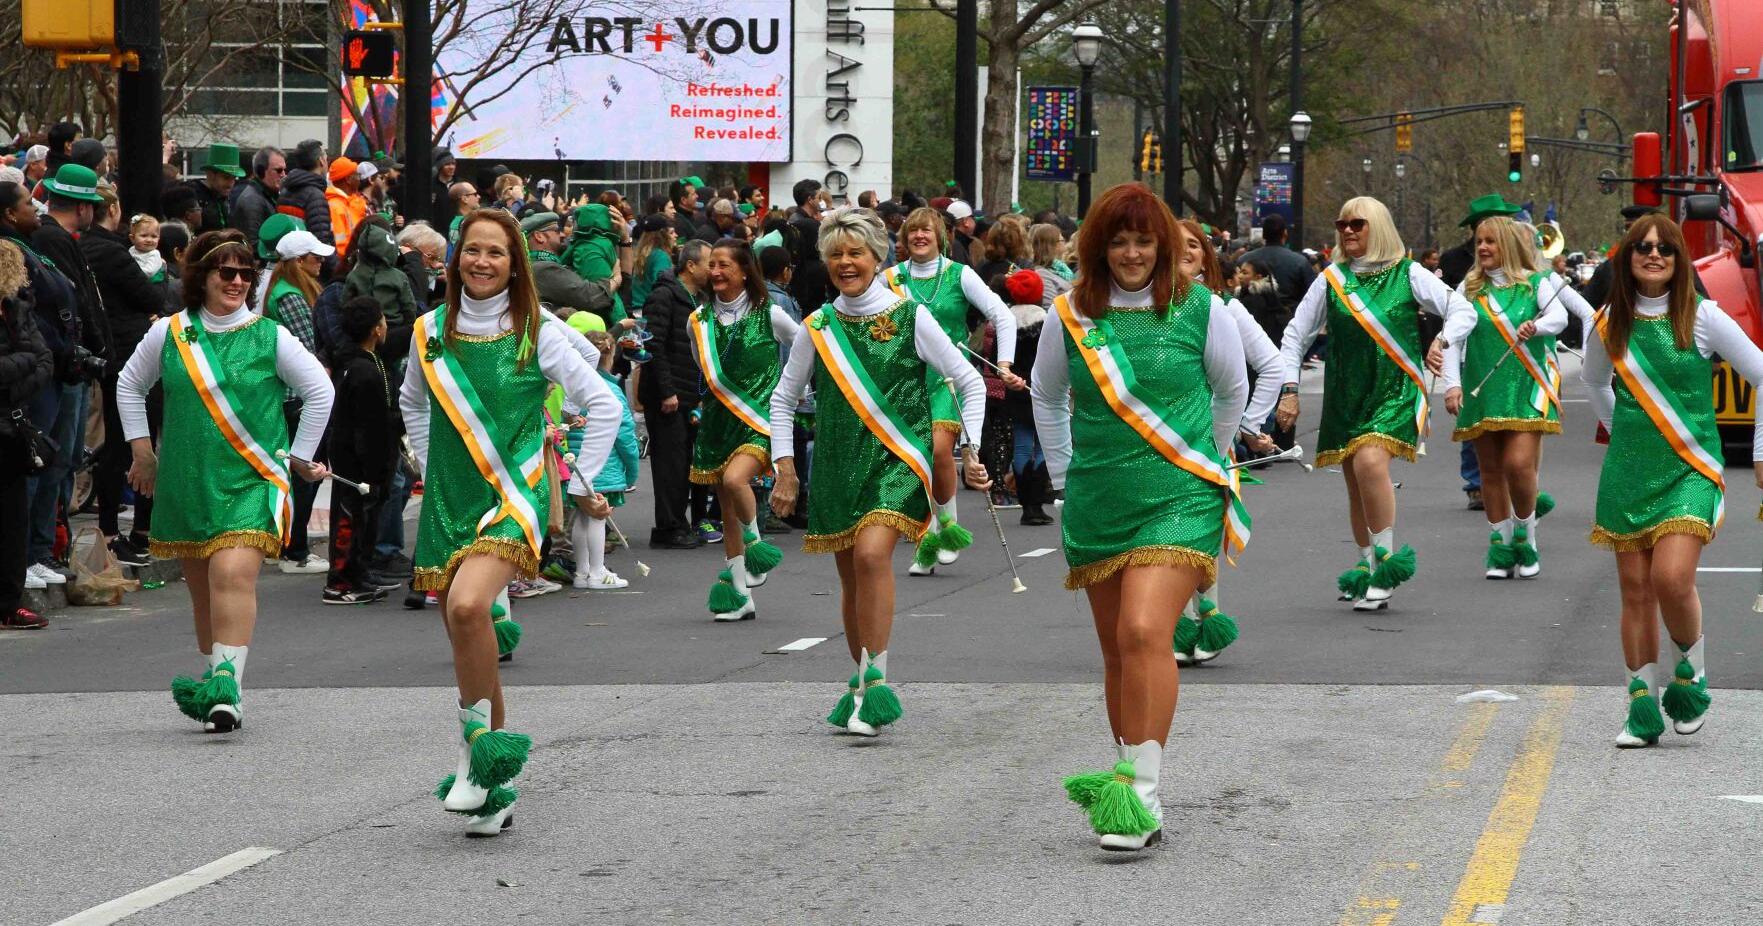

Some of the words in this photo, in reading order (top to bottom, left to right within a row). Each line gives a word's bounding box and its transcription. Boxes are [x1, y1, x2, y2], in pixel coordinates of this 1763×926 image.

[687, 82, 782, 97] Refreshed.
[825, 48, 864, 122] Arts
[670, 104, 782, 122] Reimagined.
[694, 125, 782, 140] Revealed.
